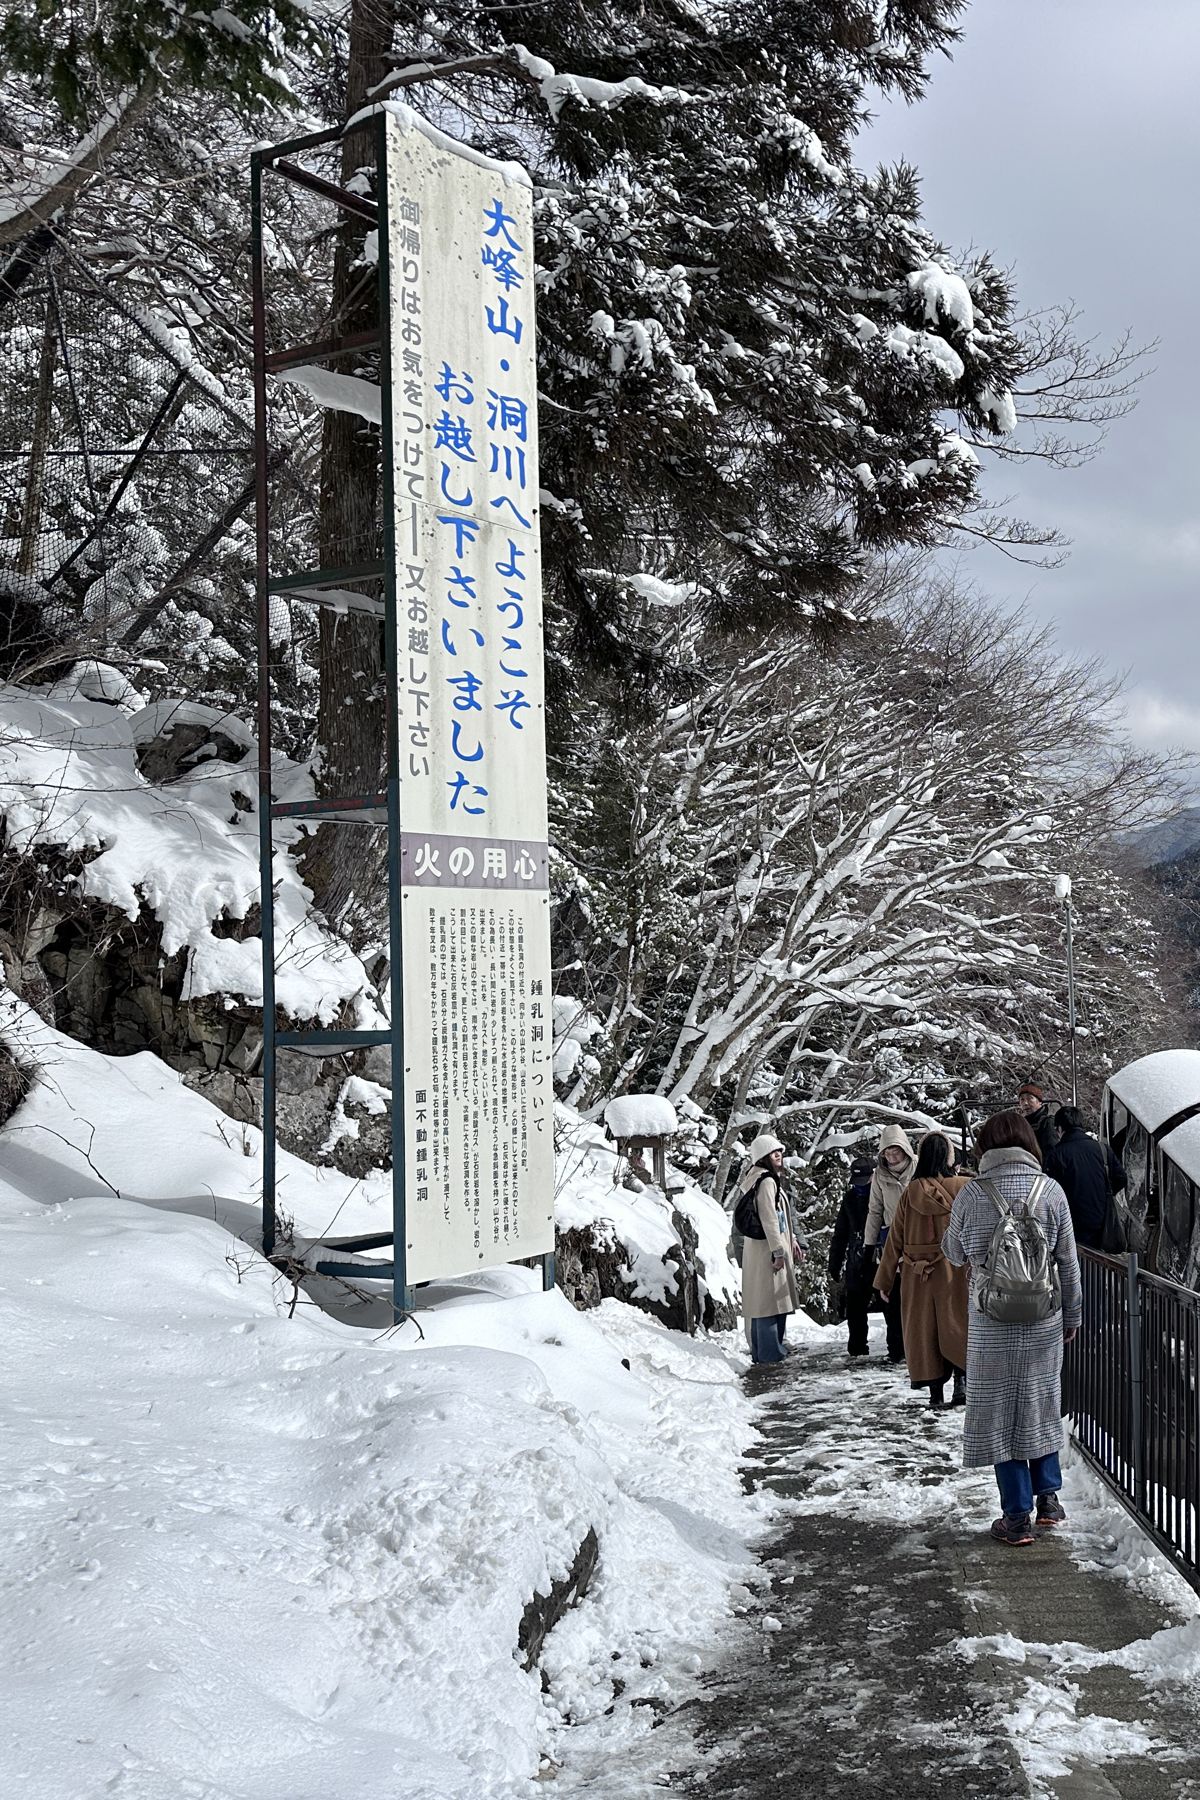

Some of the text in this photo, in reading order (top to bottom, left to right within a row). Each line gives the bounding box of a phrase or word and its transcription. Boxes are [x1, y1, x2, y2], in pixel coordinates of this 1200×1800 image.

[481, 198, 532, 730] 大峰山・洞川へようこそ
[433, 361, 489, 815] お越し下さいました
[414, 843, 537, 881] 火の用心
[530, 979, 545, 1133] 鍾乳洞について
[415, 1089, 428, 1203] 面不動鍾乳洞
